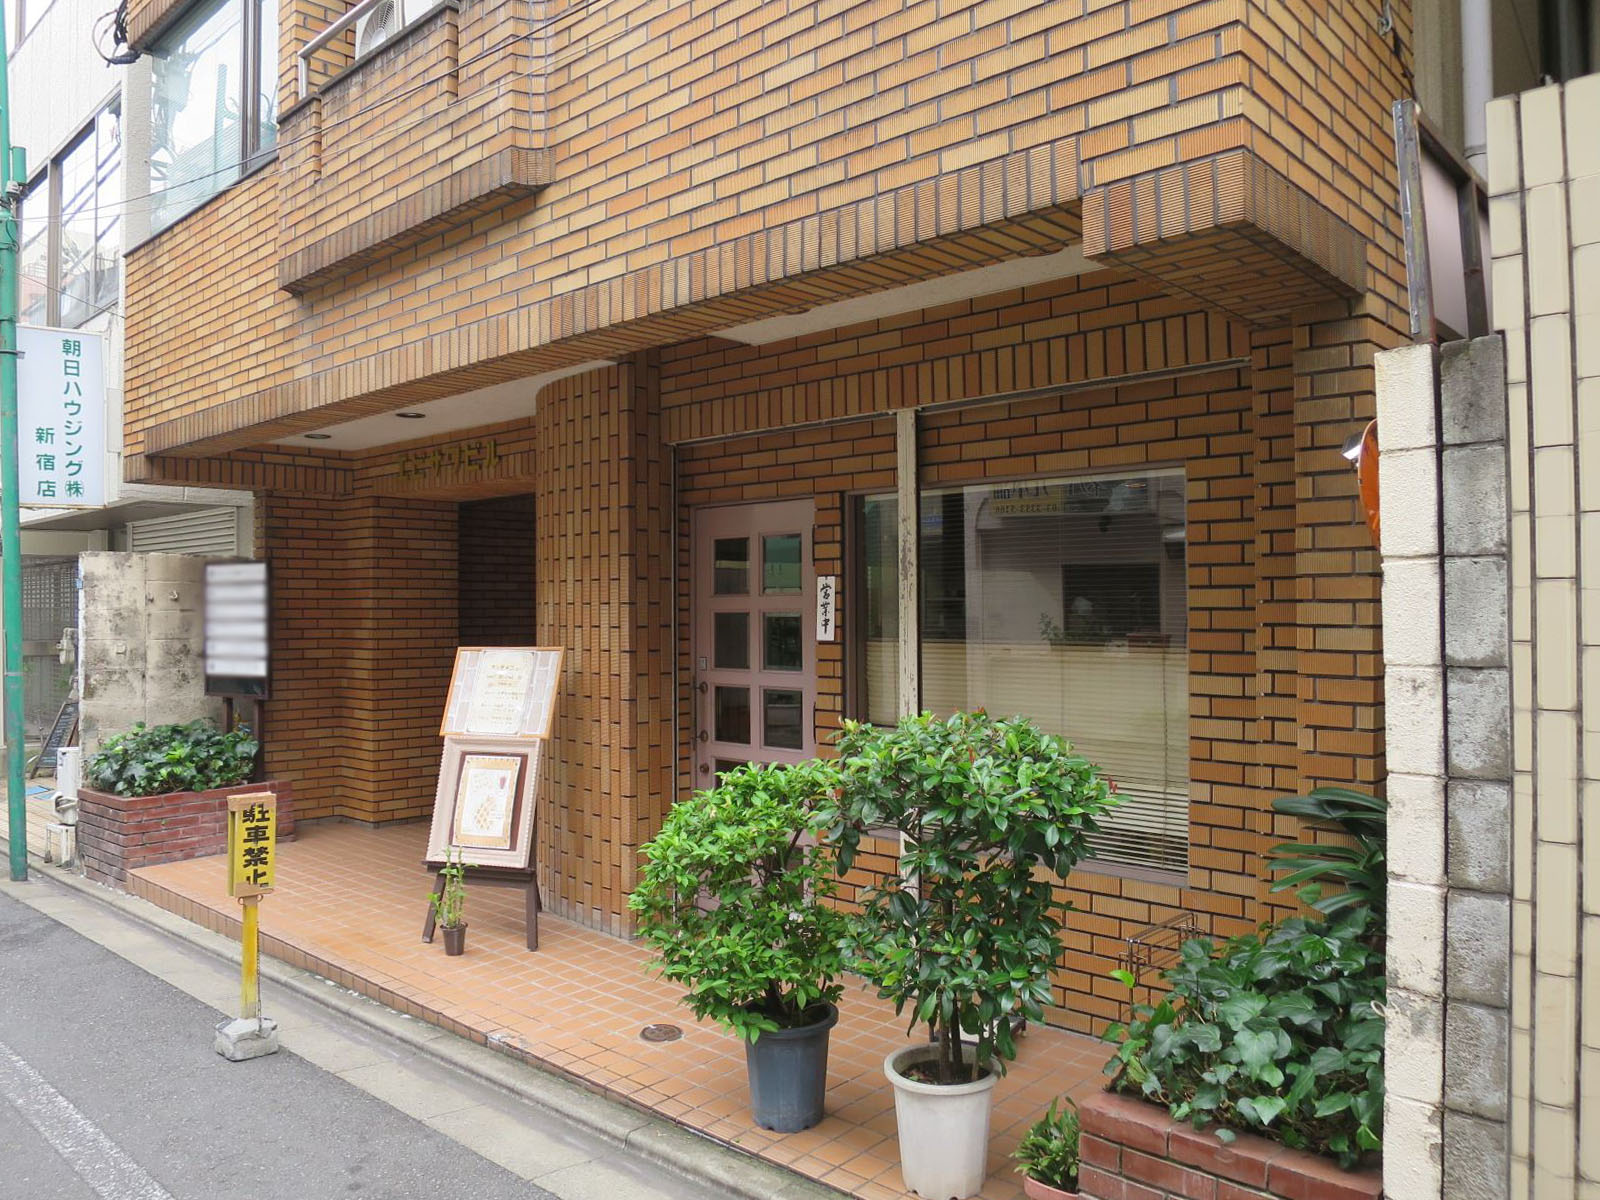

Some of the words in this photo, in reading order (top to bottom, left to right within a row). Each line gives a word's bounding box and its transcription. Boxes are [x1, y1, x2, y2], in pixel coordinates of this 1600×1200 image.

[35, 426, 57, 498] 新宿店
[820, 582, 832, 635] 営業中
[242, 802, 271, 888] 駐車禁止
